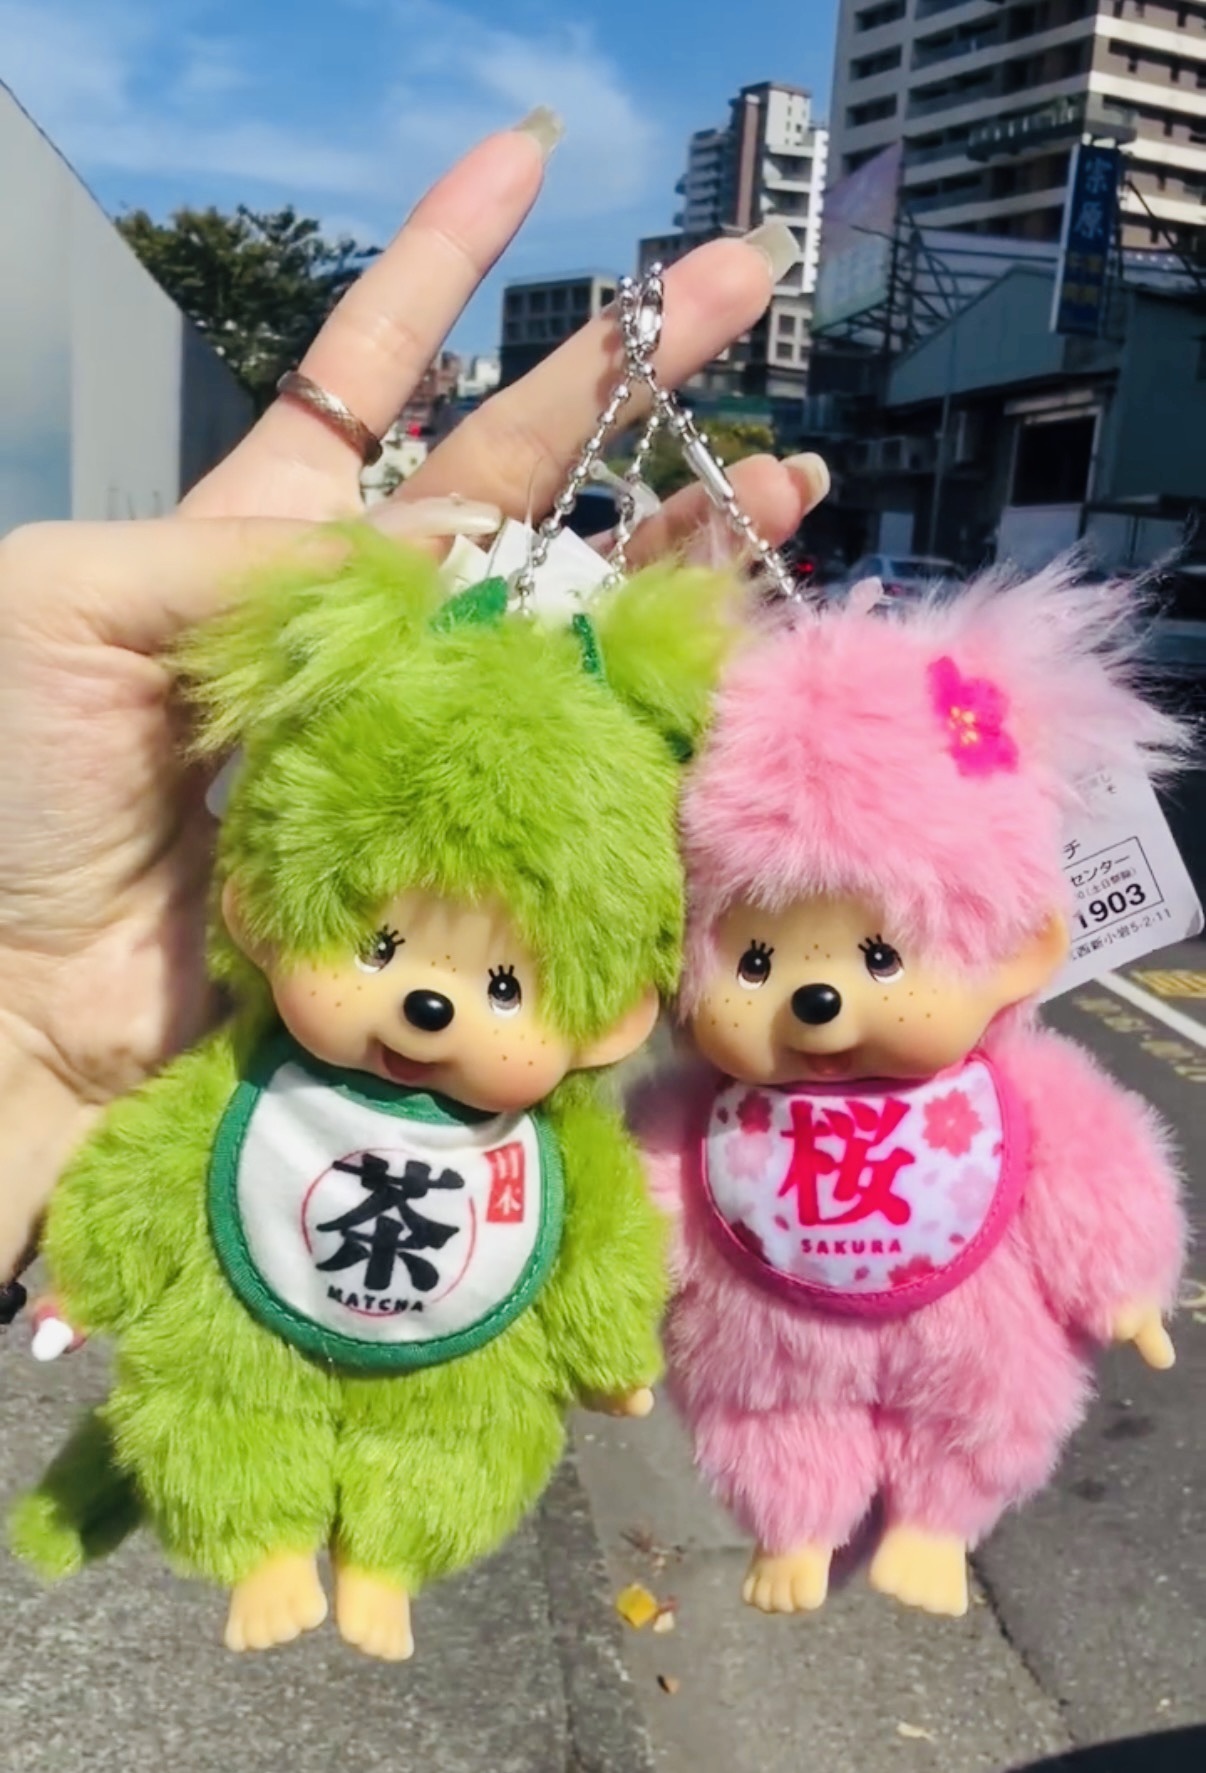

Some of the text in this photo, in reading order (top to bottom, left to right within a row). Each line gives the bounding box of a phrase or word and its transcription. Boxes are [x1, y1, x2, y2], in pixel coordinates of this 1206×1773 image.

[1070, 855, 1131, 888] センター
[778, 1097, 915, 1226] 桜
[315, 1152, 465, 1293] 茶
[801, 1238, 902, 1255] SAKURA
[326, 1284, 426, 1314] MATCHA
